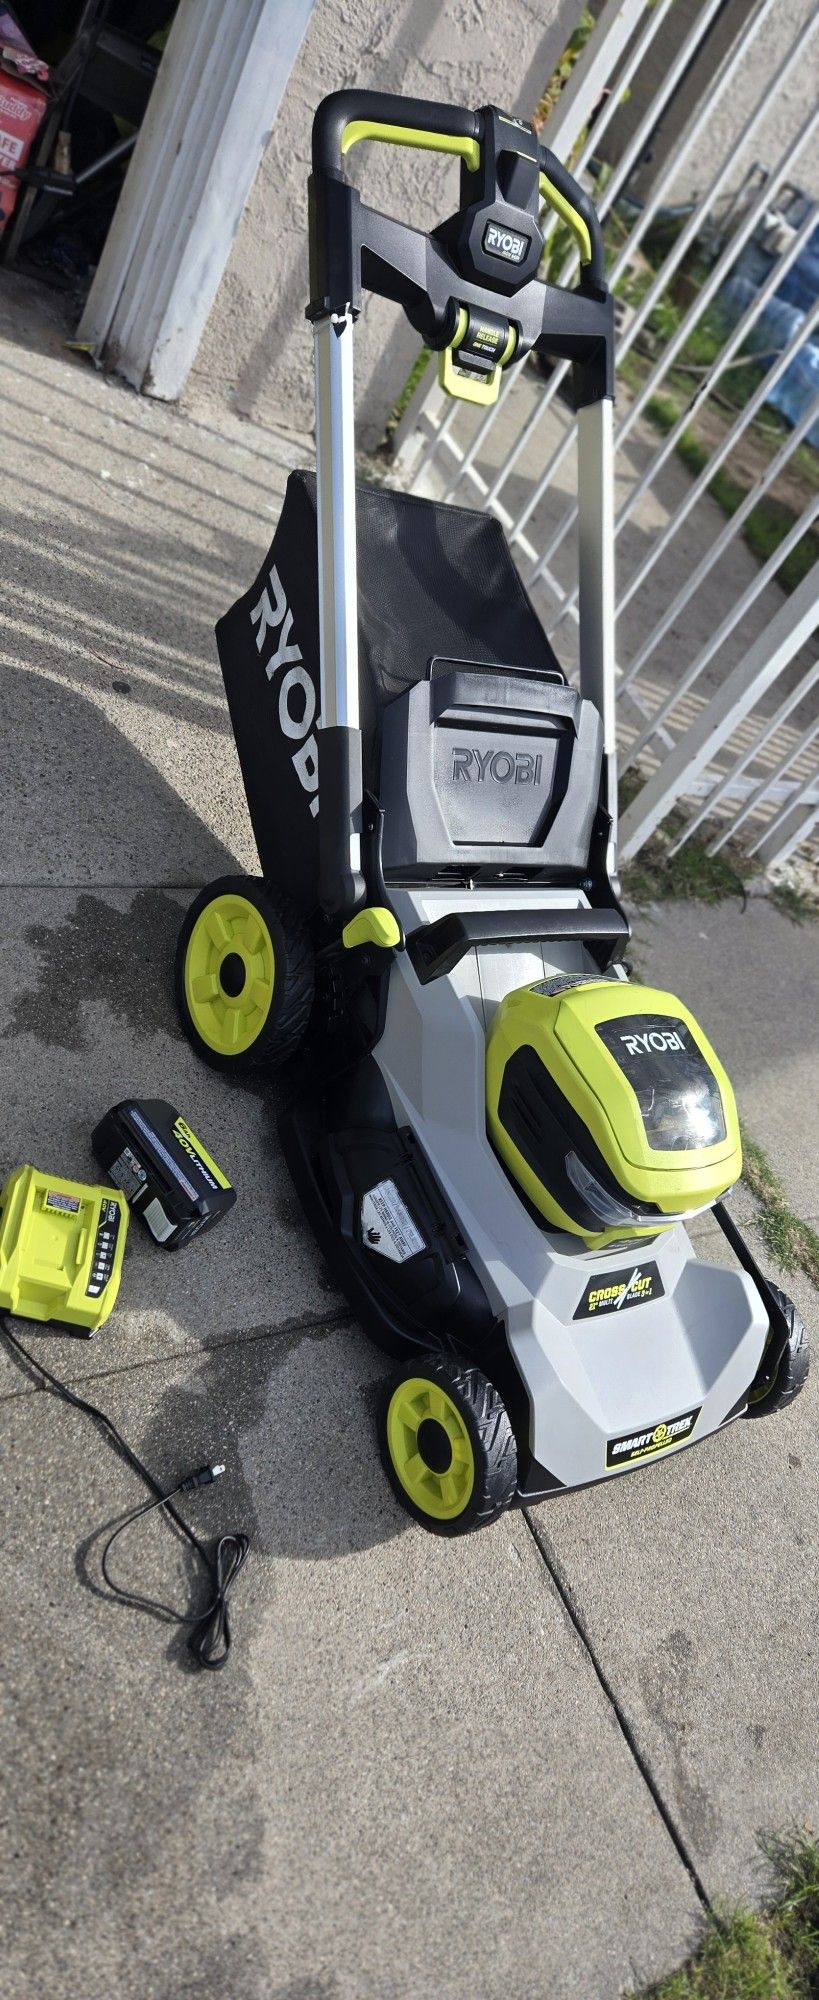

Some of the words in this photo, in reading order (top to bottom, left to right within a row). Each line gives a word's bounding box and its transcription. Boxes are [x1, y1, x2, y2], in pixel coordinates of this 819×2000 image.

[0, 136, 17, 153] FE
[488, 227, 525, 256] RYOBI
[476, 331, 499, 345] RELEASE
[452, 747, 543, 786] RYOBI
[620, 1032, 686, 1056] RYOBI
[108, 1201, 117, 1222] RYOBI
[588, 1284, 626, 1303] CROSS
[631, 1276, 652, 1293] CUT
[612, 1432, 653, 1455] SMART
[666, 1415, 693, 1436] TREK
